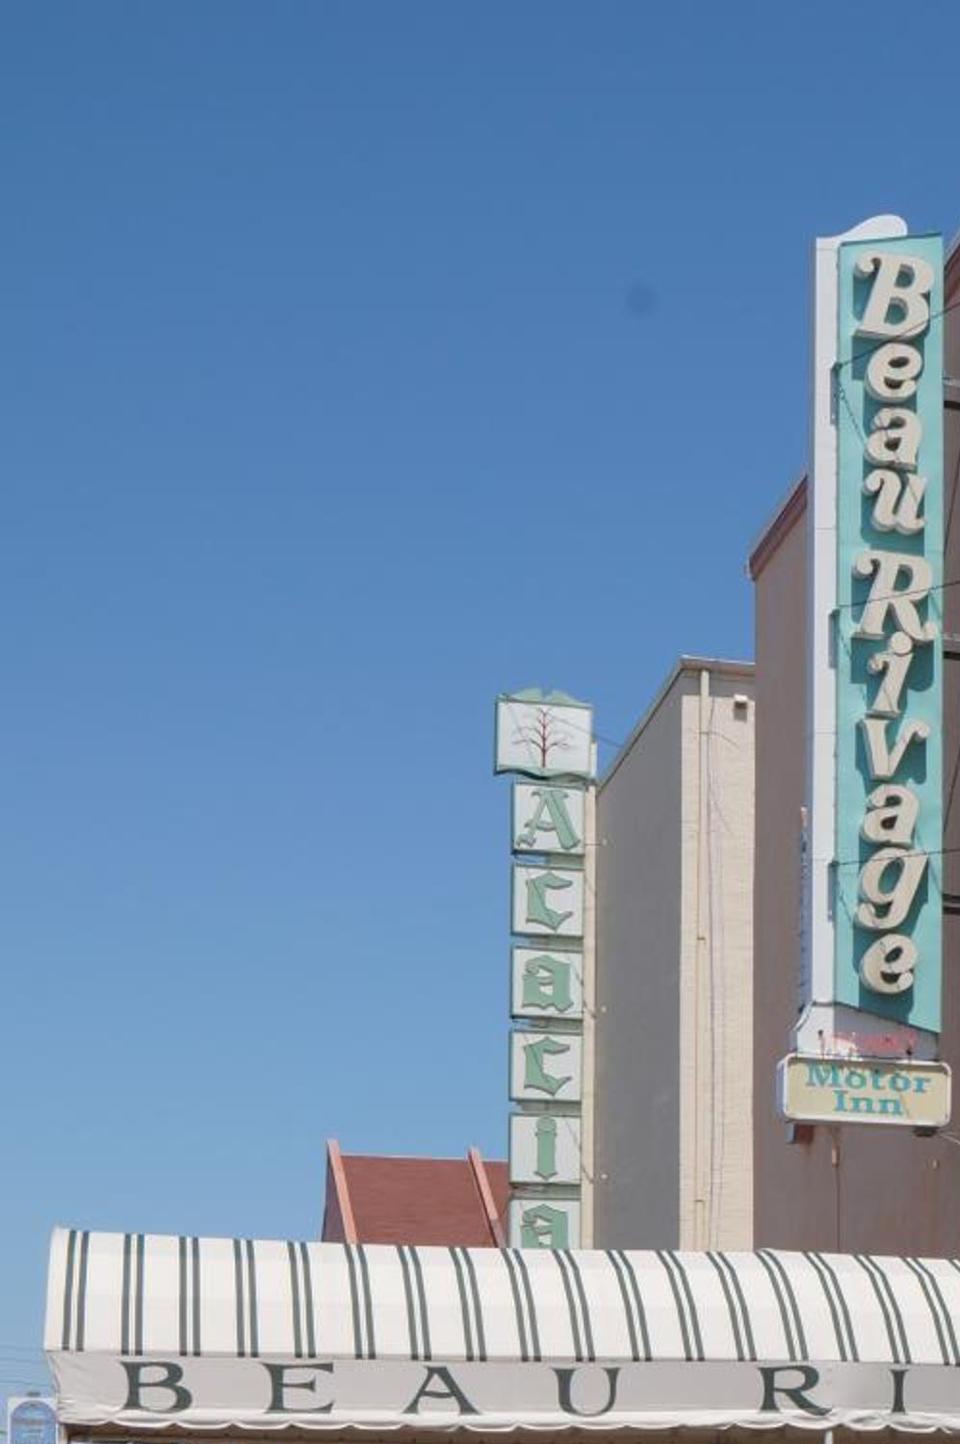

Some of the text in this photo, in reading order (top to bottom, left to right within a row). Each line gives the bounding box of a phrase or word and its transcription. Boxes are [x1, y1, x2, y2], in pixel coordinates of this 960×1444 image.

[853, 251, 935, 536] Beau
[852, 549, 938, 995] Rivage
[805, 1061, 931, 1093] Motor
[832, 1089, 904, 1116] Inn
[119, 1360, 621, 1417] BEAU
